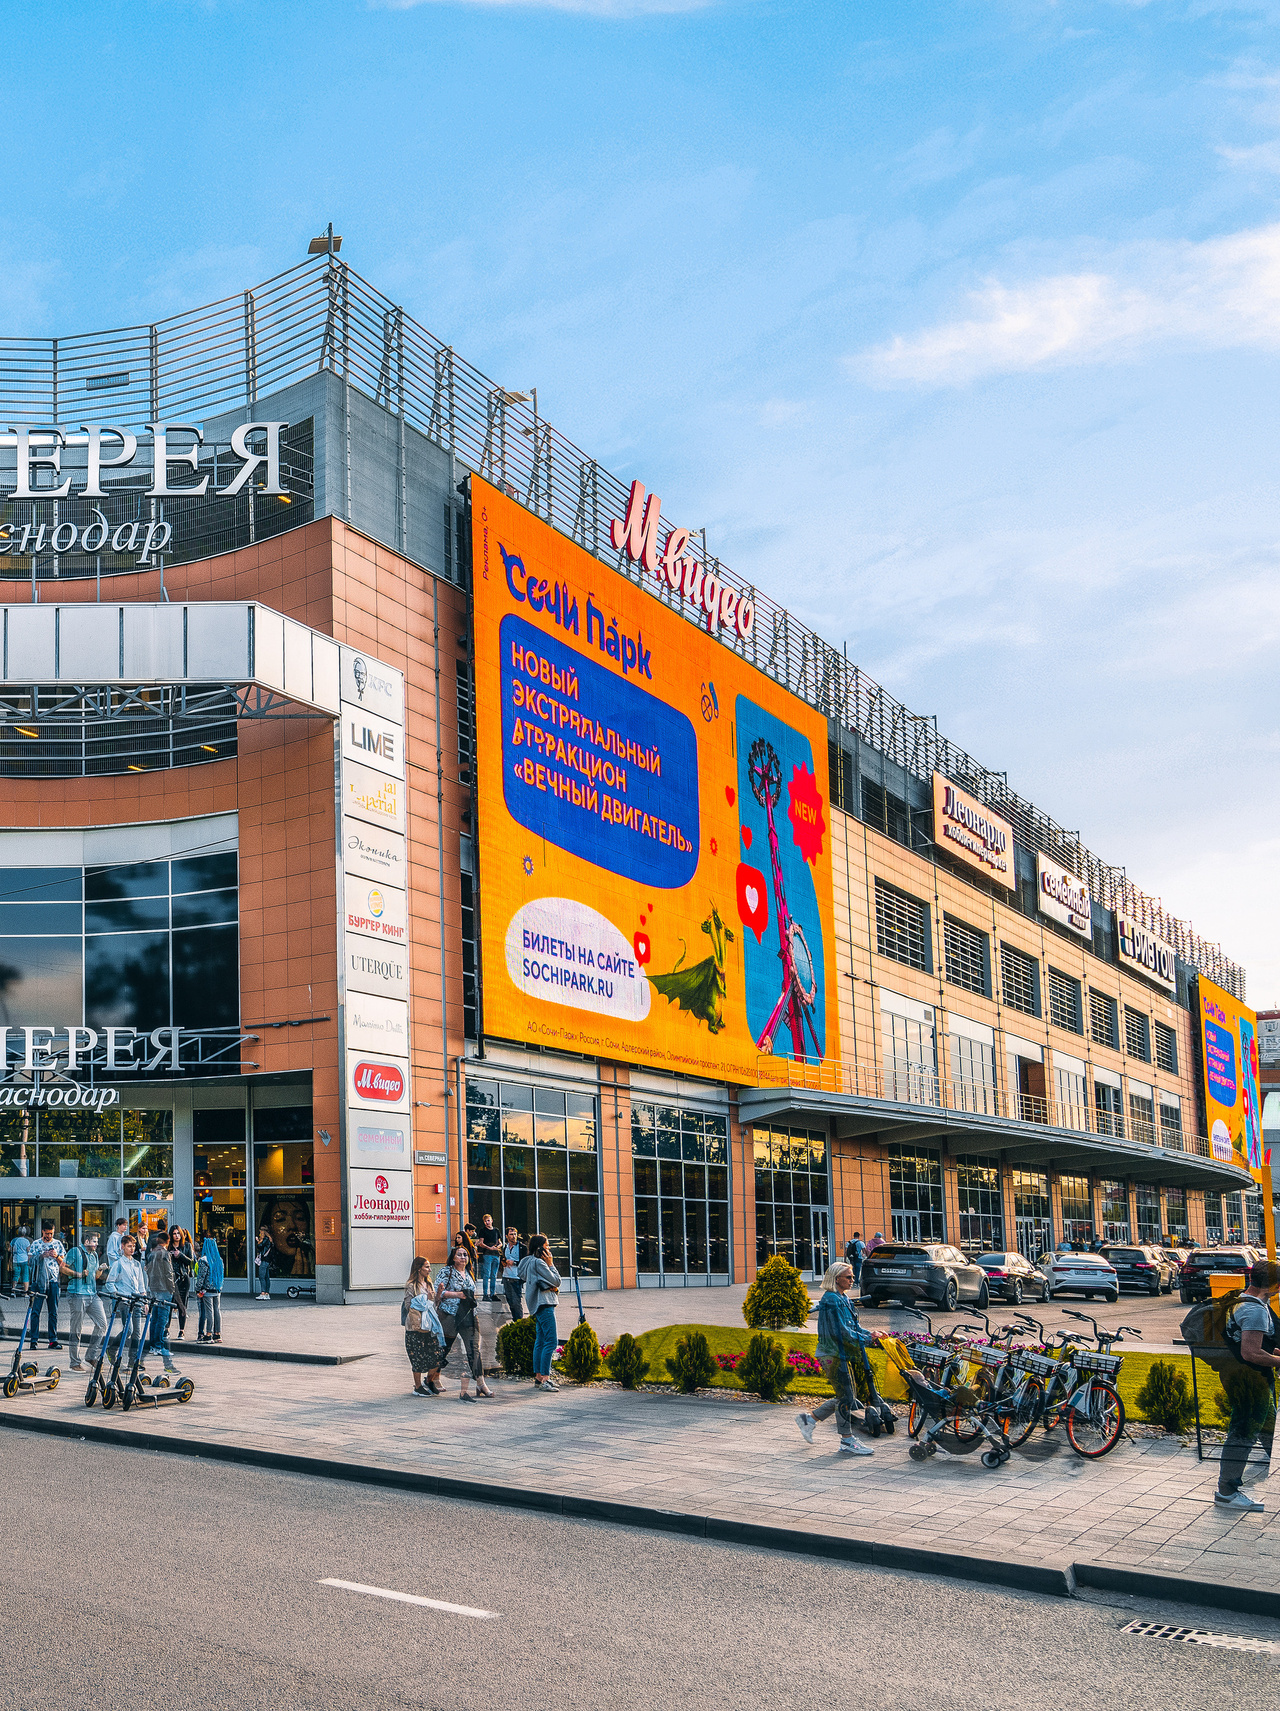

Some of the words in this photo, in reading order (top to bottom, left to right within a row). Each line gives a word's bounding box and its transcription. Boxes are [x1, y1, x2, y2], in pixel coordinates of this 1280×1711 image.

[610, 479, 756, 639] М.видео
[586, 592, 653, 680] Парк
[511, 641, 579, 701] НОВЫЙ
[368, 673, 393, 697] KFC
[514, 757, 599, 814] «ВЕЧНЫЙ
[601, 793, 693, 853] ДВИГАТЕЛЬ»
[795, 799, 817, 826] NEW
[942, 786, 1007, 855] Леонардо
[348, 835, 402, 862] Эконика
[348, 914, 380, 932] БУРГЕР
[382, 923, 404, 938] КИНГ
[351, 954, 403, 980] UTERQÜE
[523, 929, 575, 962] БИЛЕТЫ
[578, 946, 595, 968] НА
[597, 952, 635, 978] САЙТЕ
[523, 958, 613, 998] SOCHIPARK.RU
[353, 1014, 384, 1030] Massimo
[527, 1021, 537, 1032] АО
[357, 1068, 401, 1095] М.видео
[354, 1195, 410, 1214] Леонардо
[354, 1213, 410, 1222] хобби-гипермаркет
